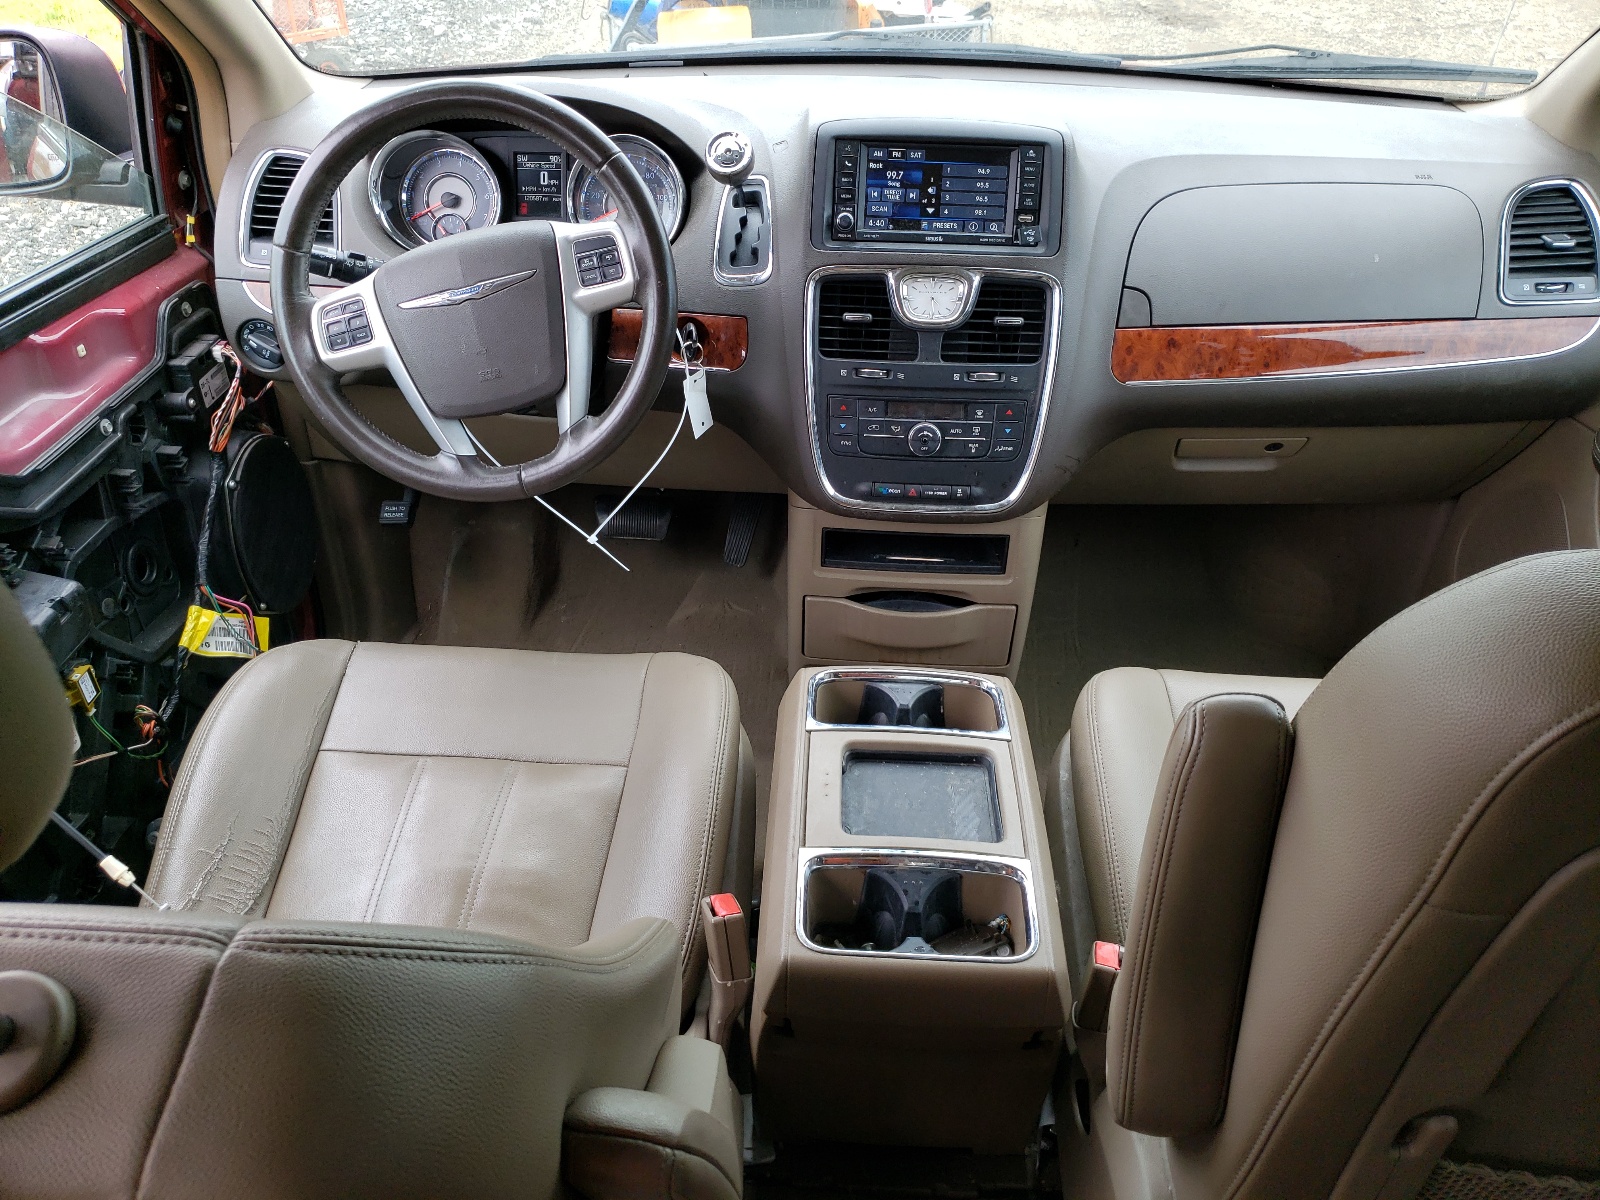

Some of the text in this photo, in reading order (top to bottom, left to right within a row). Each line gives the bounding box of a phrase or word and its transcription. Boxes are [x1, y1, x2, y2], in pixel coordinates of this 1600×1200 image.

[516, 154, 528, 162] SW
[910, 151, 922, 159] SAT
[540, 171, 548, 185] 0
[886, 170, 904, 180] 99.7
[887, 180, 901, 188] Song
[871, 205, 888, 213] SCAN
[868, 219, 885, 227] 4:40
